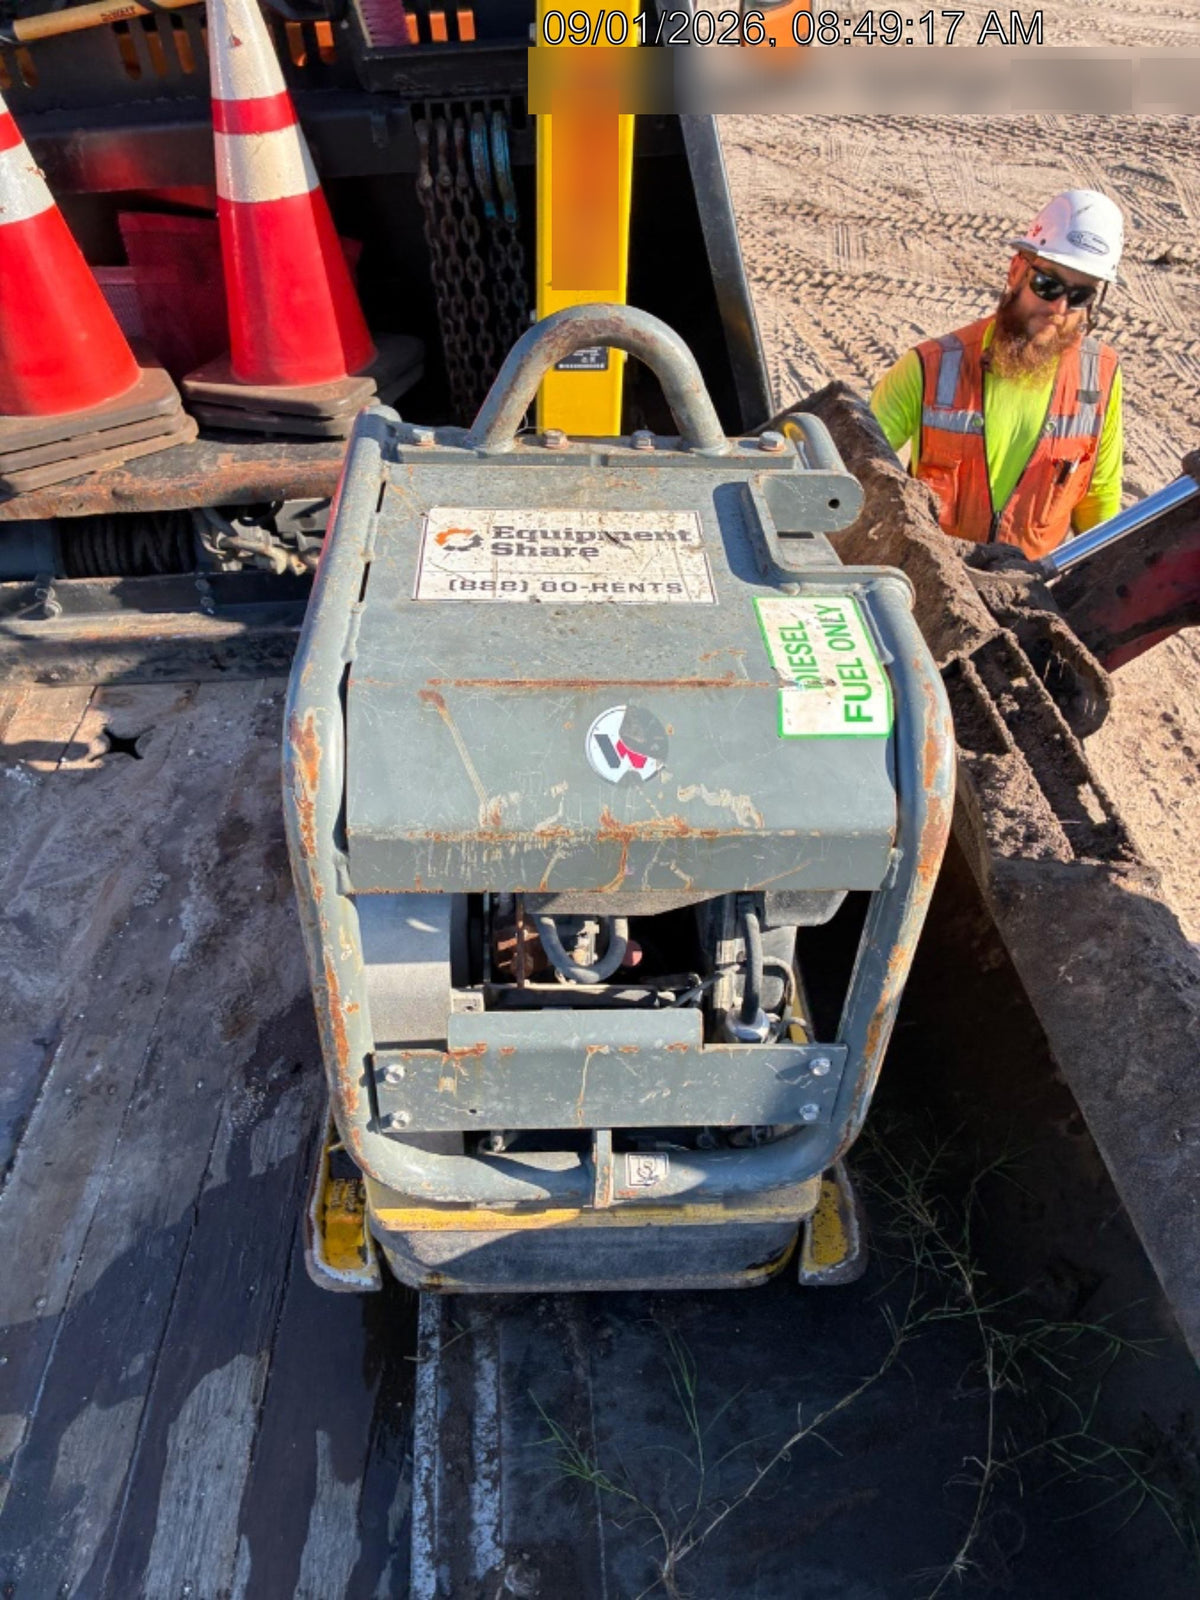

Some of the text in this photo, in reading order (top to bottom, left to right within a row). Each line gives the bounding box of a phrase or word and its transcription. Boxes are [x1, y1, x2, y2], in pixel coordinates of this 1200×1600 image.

[491, 526, 693, 543] Equipment
[490, 542, 600, 557] Share
[449, 580, 683, 593] (888) 80-RENTS
[778, 620, 825, 689] DIESEL
[814, 604, 874, 723] FUEL ONLY
